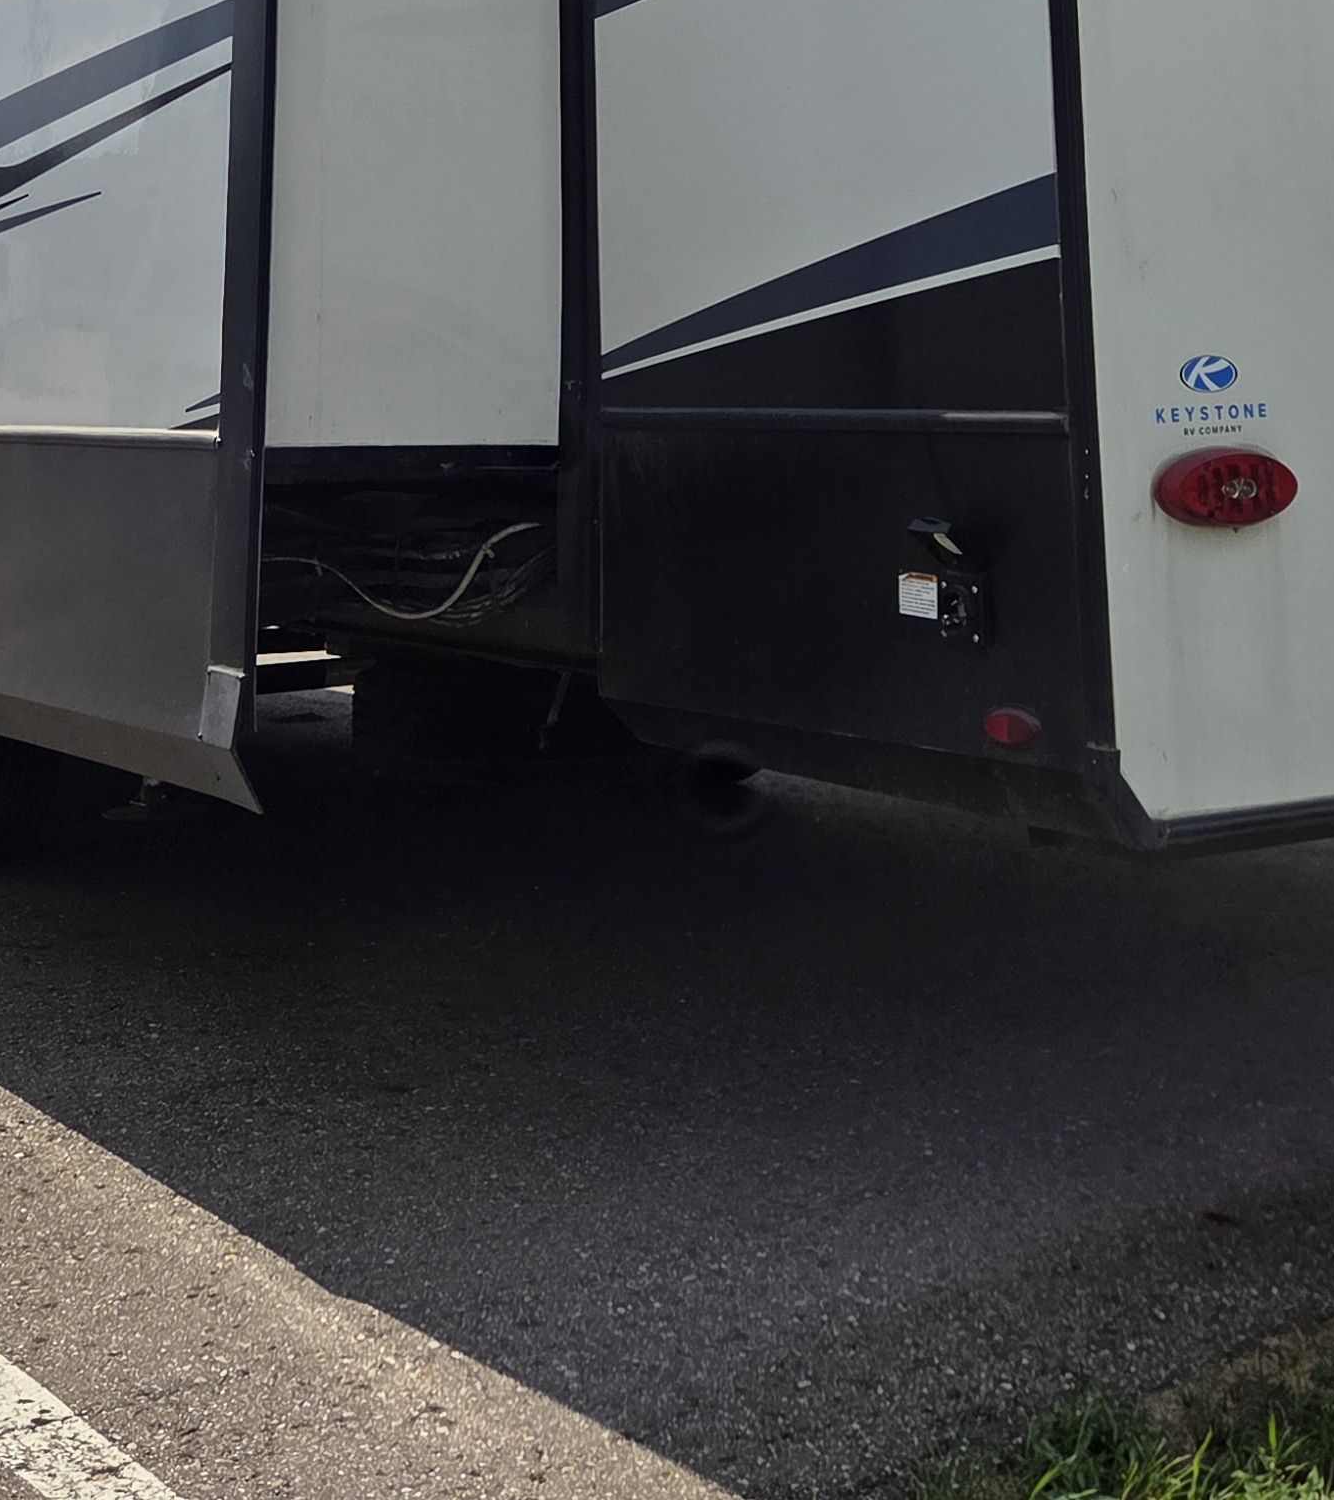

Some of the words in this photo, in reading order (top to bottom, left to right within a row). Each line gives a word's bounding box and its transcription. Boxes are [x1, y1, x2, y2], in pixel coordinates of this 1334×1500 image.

[1155, 403, 1267, 424] KEYSTONE
[1183, 427, 1195, 437] RV
[1198, 425, 1243, 436] COMPANY
